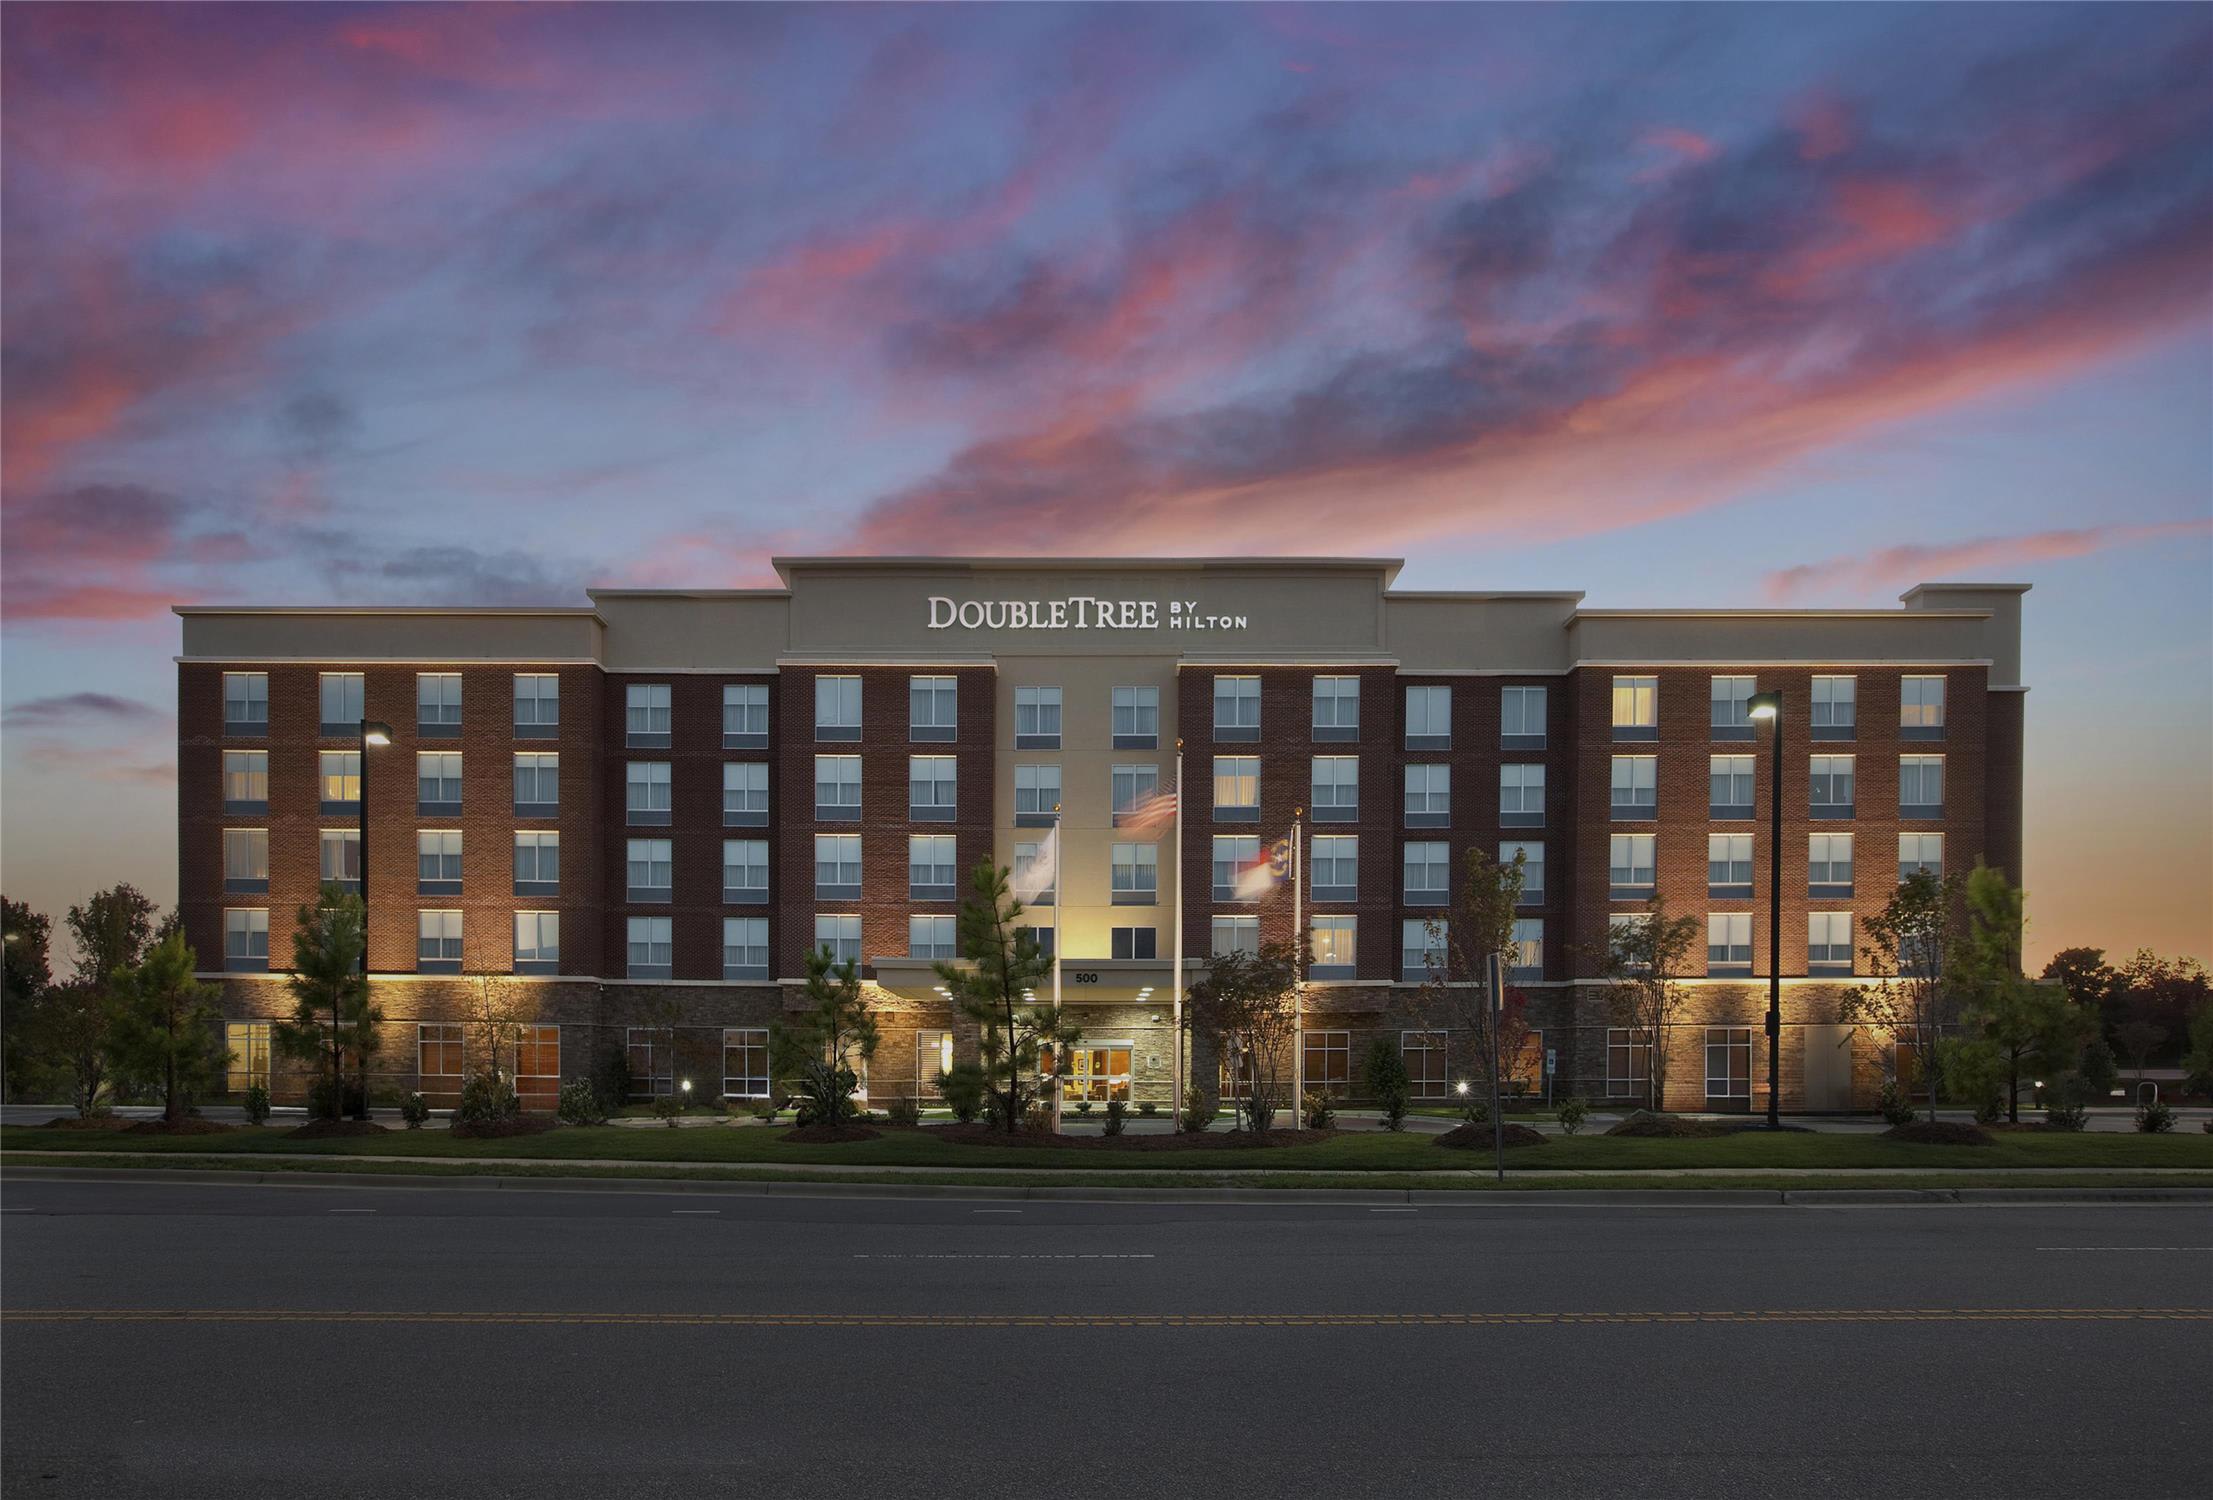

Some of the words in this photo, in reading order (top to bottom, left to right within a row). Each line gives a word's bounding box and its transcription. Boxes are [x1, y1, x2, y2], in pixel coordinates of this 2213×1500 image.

[927, 597, 1160, 629] DOUBLETREE
[1170, 601, 1198, 614] BY
[1170, 616, 1248, 629] HILTON
[1075, 973, 1098, 983] 500
